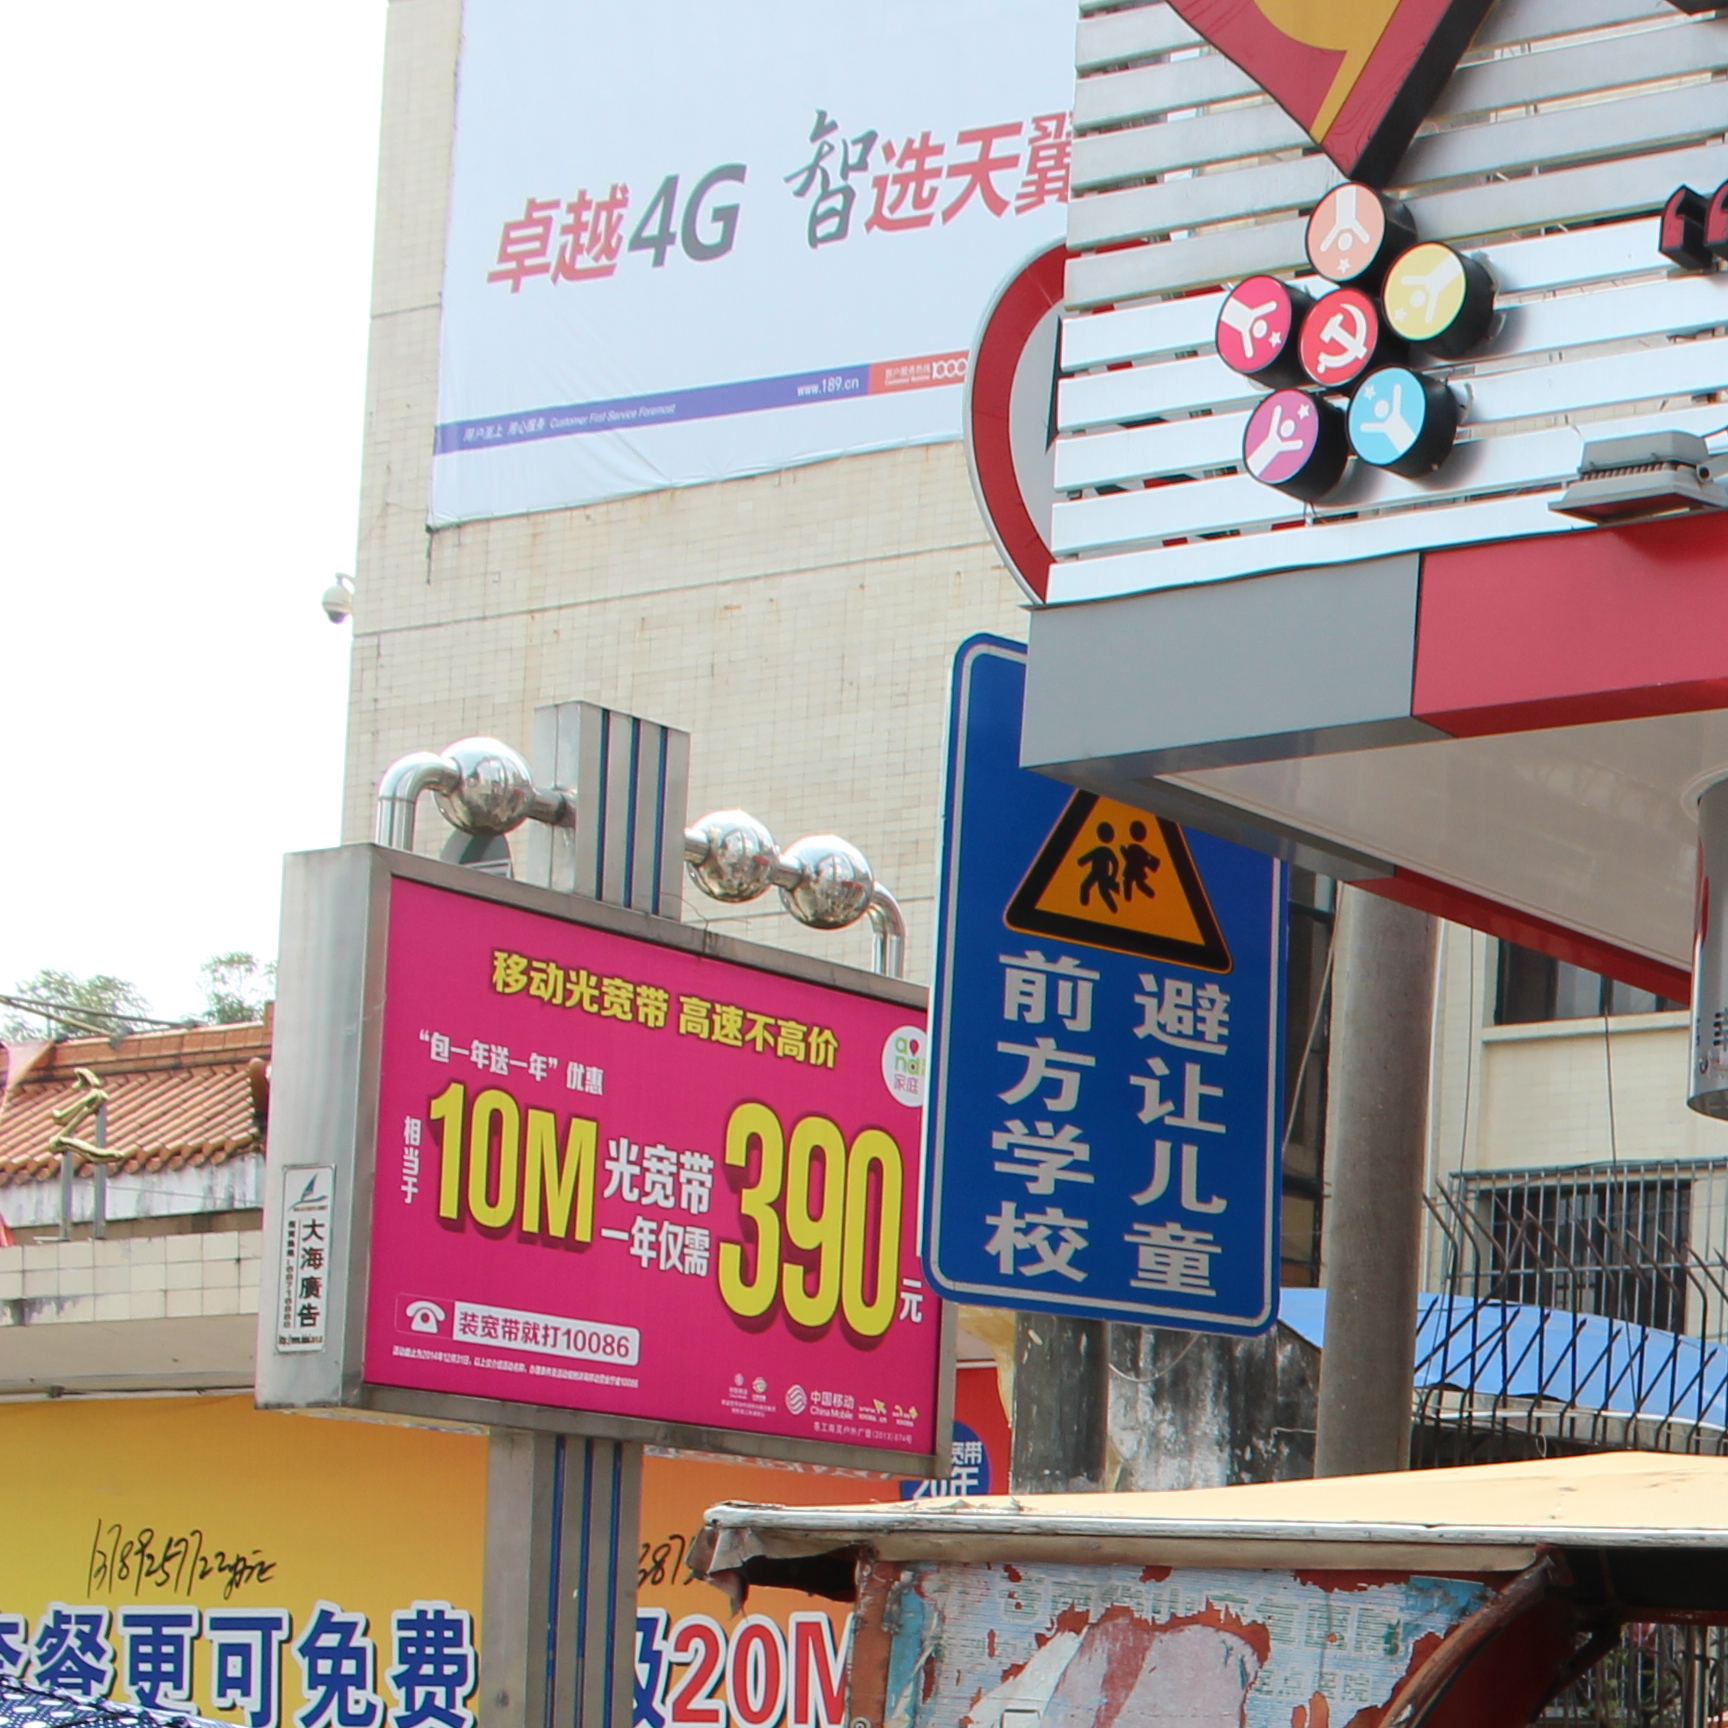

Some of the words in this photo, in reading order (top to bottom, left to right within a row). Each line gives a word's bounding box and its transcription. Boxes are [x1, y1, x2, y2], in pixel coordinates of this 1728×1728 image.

[486, 163, 747, 294] 卓越4G
[550, 415, 588, 430] Customer
[797, 376, 859, 398] www.189.cn
[491, 949, 669, 1029] 移动光宽带
[678, 995, 839, 1068] 高速不高价
[566, 1061, 604, 1095] 优惠
[985, 950, 1100, 1283] 前方学校
[402, 1116, 422, 1204] 相当于
[428, 1082, 599, 1245] 10M
[603, 1137, 714, 1215] 光宽带
[1123, 971, 1231, 1298] 避让儿童
[601, 1216, 711, 1279] 一年仅需
[717, 1101, 904, 1338] 390
[899, 1278, 923, 1324] 元
[297, 1217, 326, 1328] 大海廣告
[459, 1310, 630, 1358] 装宽带就打10086
[810, 1390, 855, 1411] 中国移动
